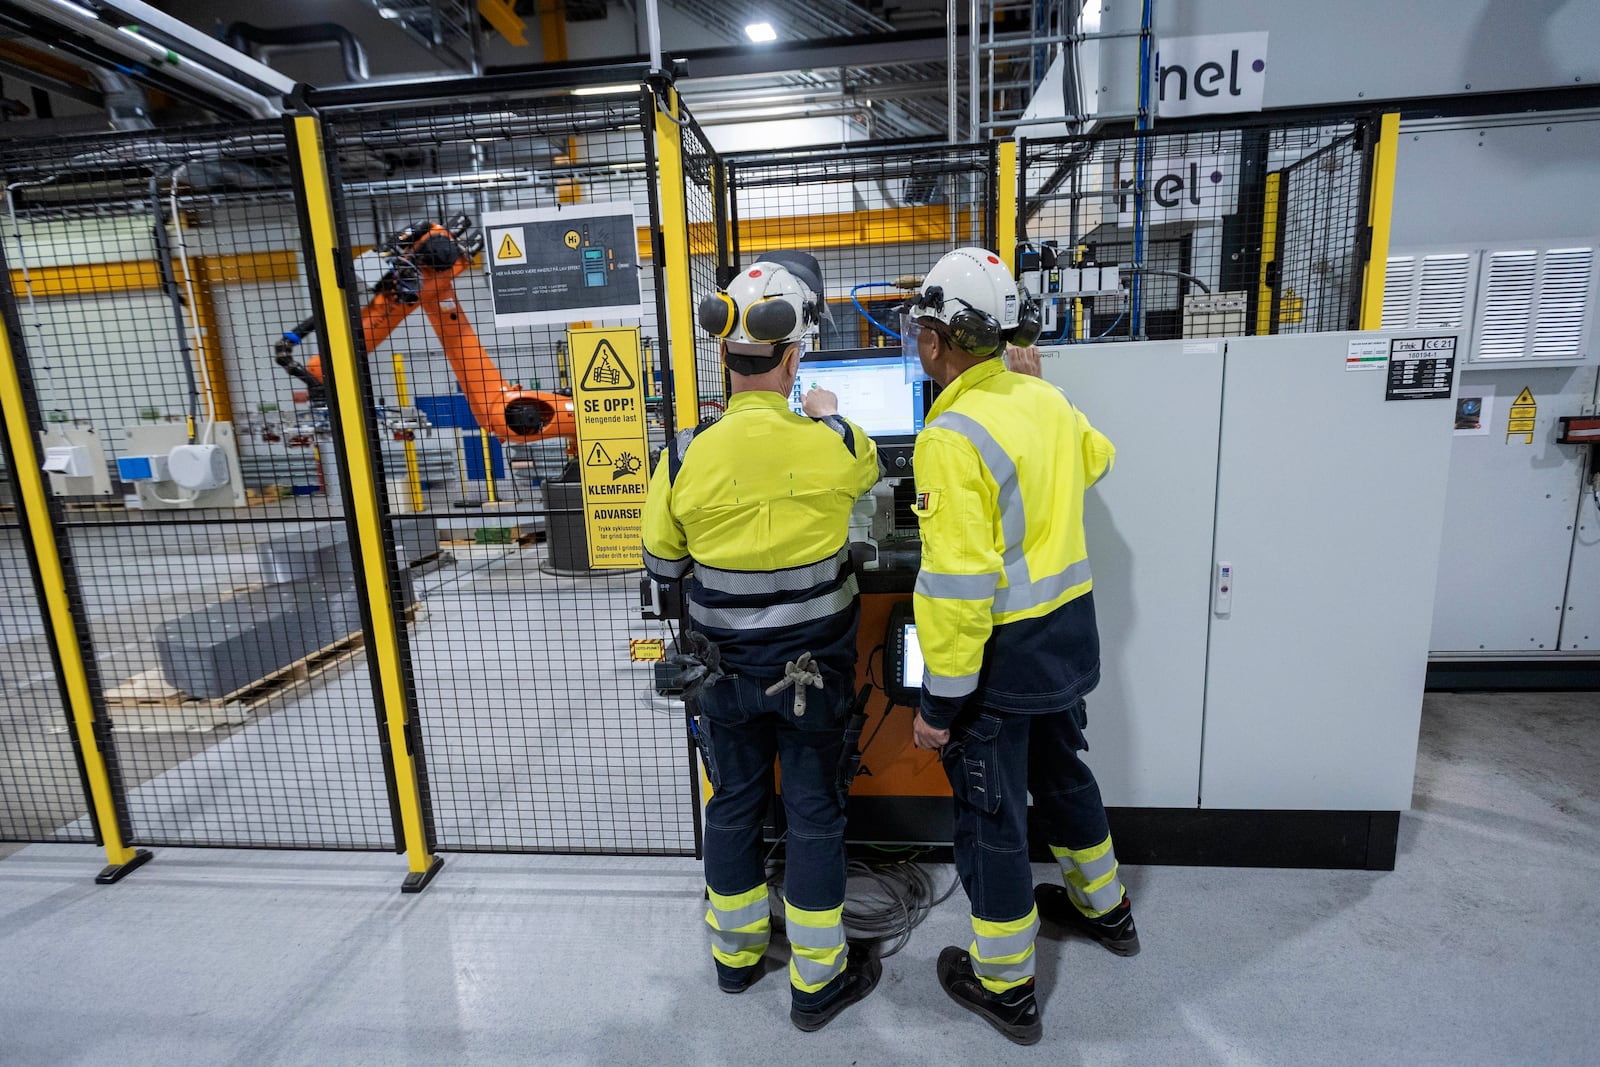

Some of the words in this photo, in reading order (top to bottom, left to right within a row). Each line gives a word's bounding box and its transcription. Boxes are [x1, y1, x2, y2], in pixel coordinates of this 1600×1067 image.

[1159, 50, 1241, 101] nel
[568, 236, 577, 244] Hi
[584, 400, 600, 412] SE
[604, 398, 634, 412] OPP!
[584, 415, 621, 424] Hengende
[622, 414, 636, 422] last
[588, 484, 645, 495] KLEMFARE!
